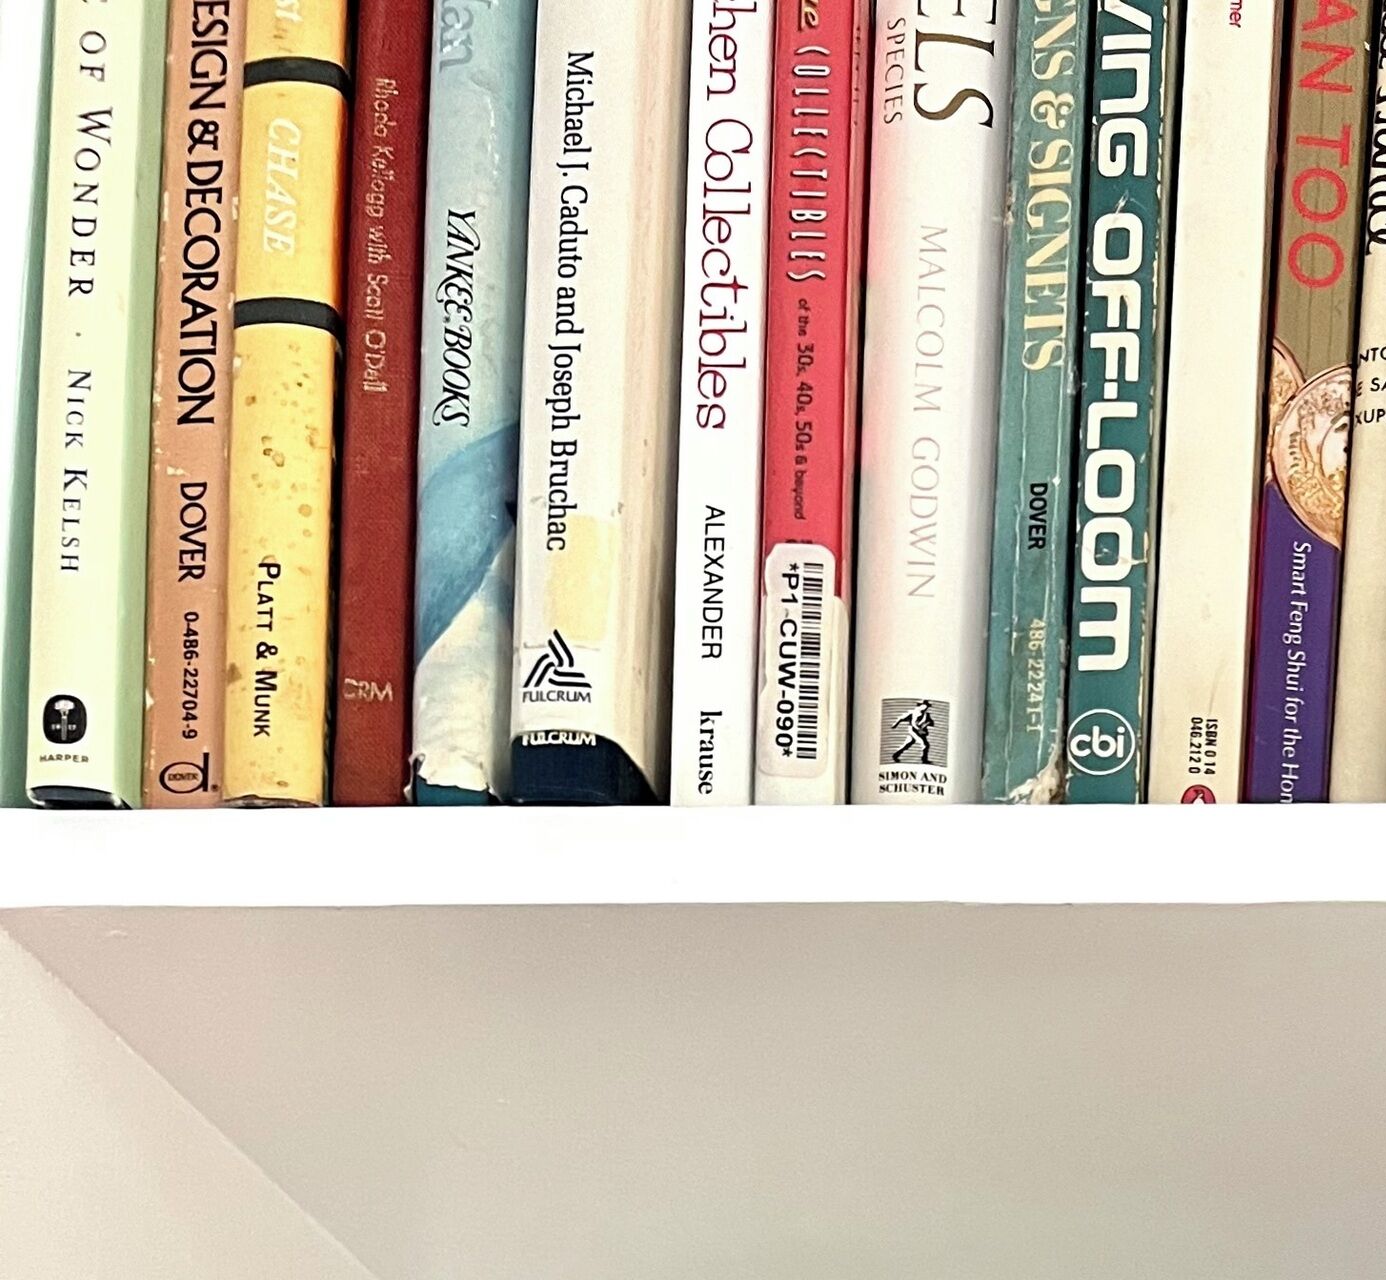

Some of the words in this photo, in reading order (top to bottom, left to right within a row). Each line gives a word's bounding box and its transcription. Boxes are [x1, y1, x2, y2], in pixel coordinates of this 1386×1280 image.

[78, 30, 106, 83] OF
[563, 51, 595, 154] Michael
[884, 17, 905, 125] SPECIES
[557, 161, 589, 177] J.
[1288, 124, 1350, 288] TOO
[558, 185, 589, 279] Caduto
[697, 117, 754, 429] Collectibles
[1022, 138, 1074, 371] SIGNETS
[177, 160, 224, 425] DECORATION
[556, 286, 584, 336] and
[912, 224, 949, 412] MALCOLM
[546, 343, 581, 431] Joseph
[1078, 212, 1144, 671] OFF-LOOM
[178, 481, 207, 582] DOVER
[546, 439, 577, 552] Bruchac
[907, 436, 941, 599] GODWIN
[1027, 482, 1048, 550] DOVER
[701, 504, 725, 660] ALEXANDER
[256, 642, 277, 660] &
[522, 689, 591, 703] FULCRUM
[699, 710, 723, 795] krause
[1070, 727, 1125, 758] cbi
